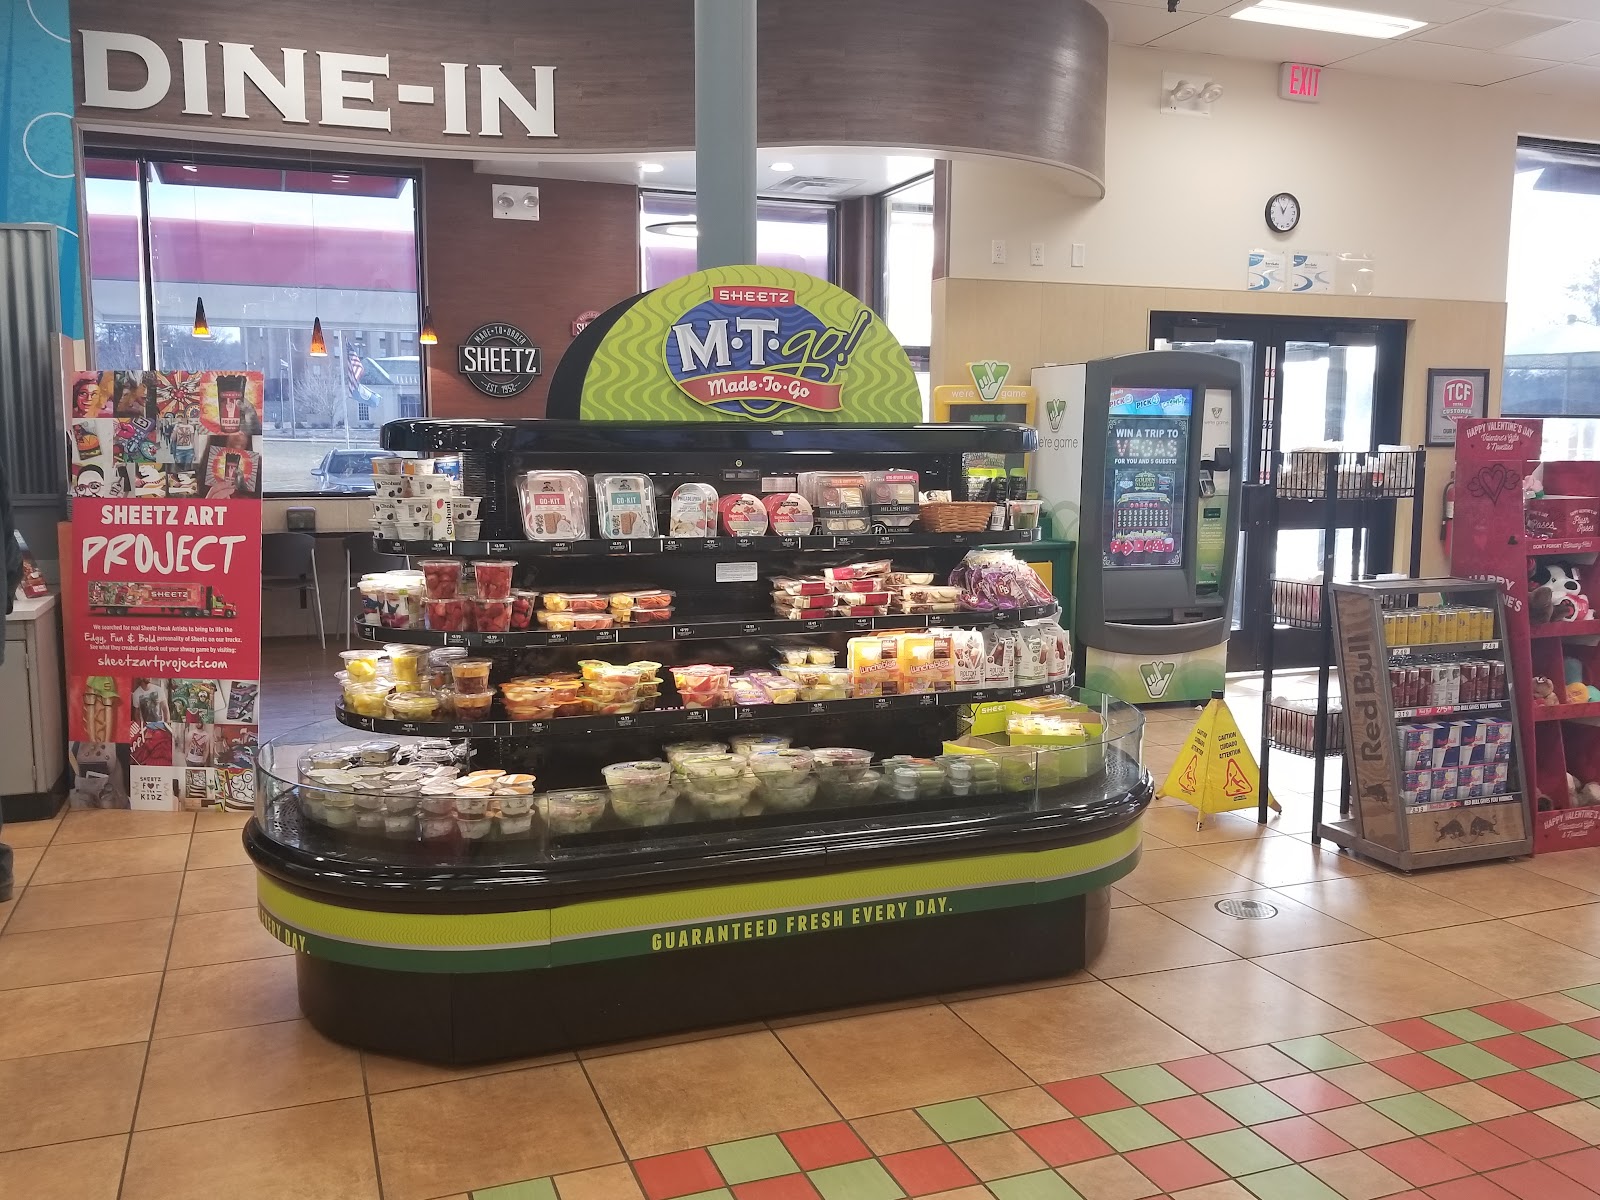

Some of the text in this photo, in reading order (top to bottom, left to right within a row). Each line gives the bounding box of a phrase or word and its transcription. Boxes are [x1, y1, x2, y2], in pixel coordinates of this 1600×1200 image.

[78, 29, 558, 138] DINE-IN
[1289, 65, 1321, 97] EXIT
[719, 290, 789, 303] SHEETZ
[464, 347, 536, 373] SHEETZ
[951, 390, 1027, 398] we're game
[1446, 382, 1472, 401] TCF
[1110, 398, 1124, 407] PICK
[1137, 399, 1151, 408] PICK
[1116, 429, 1179, 438] WIN A TRIP TO
[1466, 421, 1535, 438] HAPPY VALENTINE'S DAY
[1039, 436, 1078, 451] e're game
[1116, 439, 1177, 457] VEGAS
[539, 497, 561, 505] GO-KIT
[616, 497, 637, 505] GO-KIT
[100, 505, 227, 526] SHEETZ ART
[445, 501, 453, 535] Chobani
[82, 531, 247, 575] PROJECT
[151, 590, 188, 598] SHEETZ
[84, 632, 106, 644] Edgy,
[110, 633, 124, 642] Fun
[127, 633, 135, 644] &
[138, 633, 156, 643] Bold
[98, 654, 228, 673] sheetzartproject.com
[860, 660, 897, 674] Lunchables
[910, 660, 949, 674] Lunchables
[1347, 634, 1383, 761] Red Bull
[981, 704, 1007, 714] SHEET
[1218, 731, 1237, 742] CAUTION
[1219, 740, 1238, 751] CUIDADO
[1219, 748, 1242, 759] ATTENTION
[140, 793, 162, 801] KIDZ
[1544, 810, 1598, 829] HAPPY VALENTINE'S
[652, 897, 953, 951] GUARANTEED FRESH EVERY DAY.
[285, 928, 311, 954] DAY.
